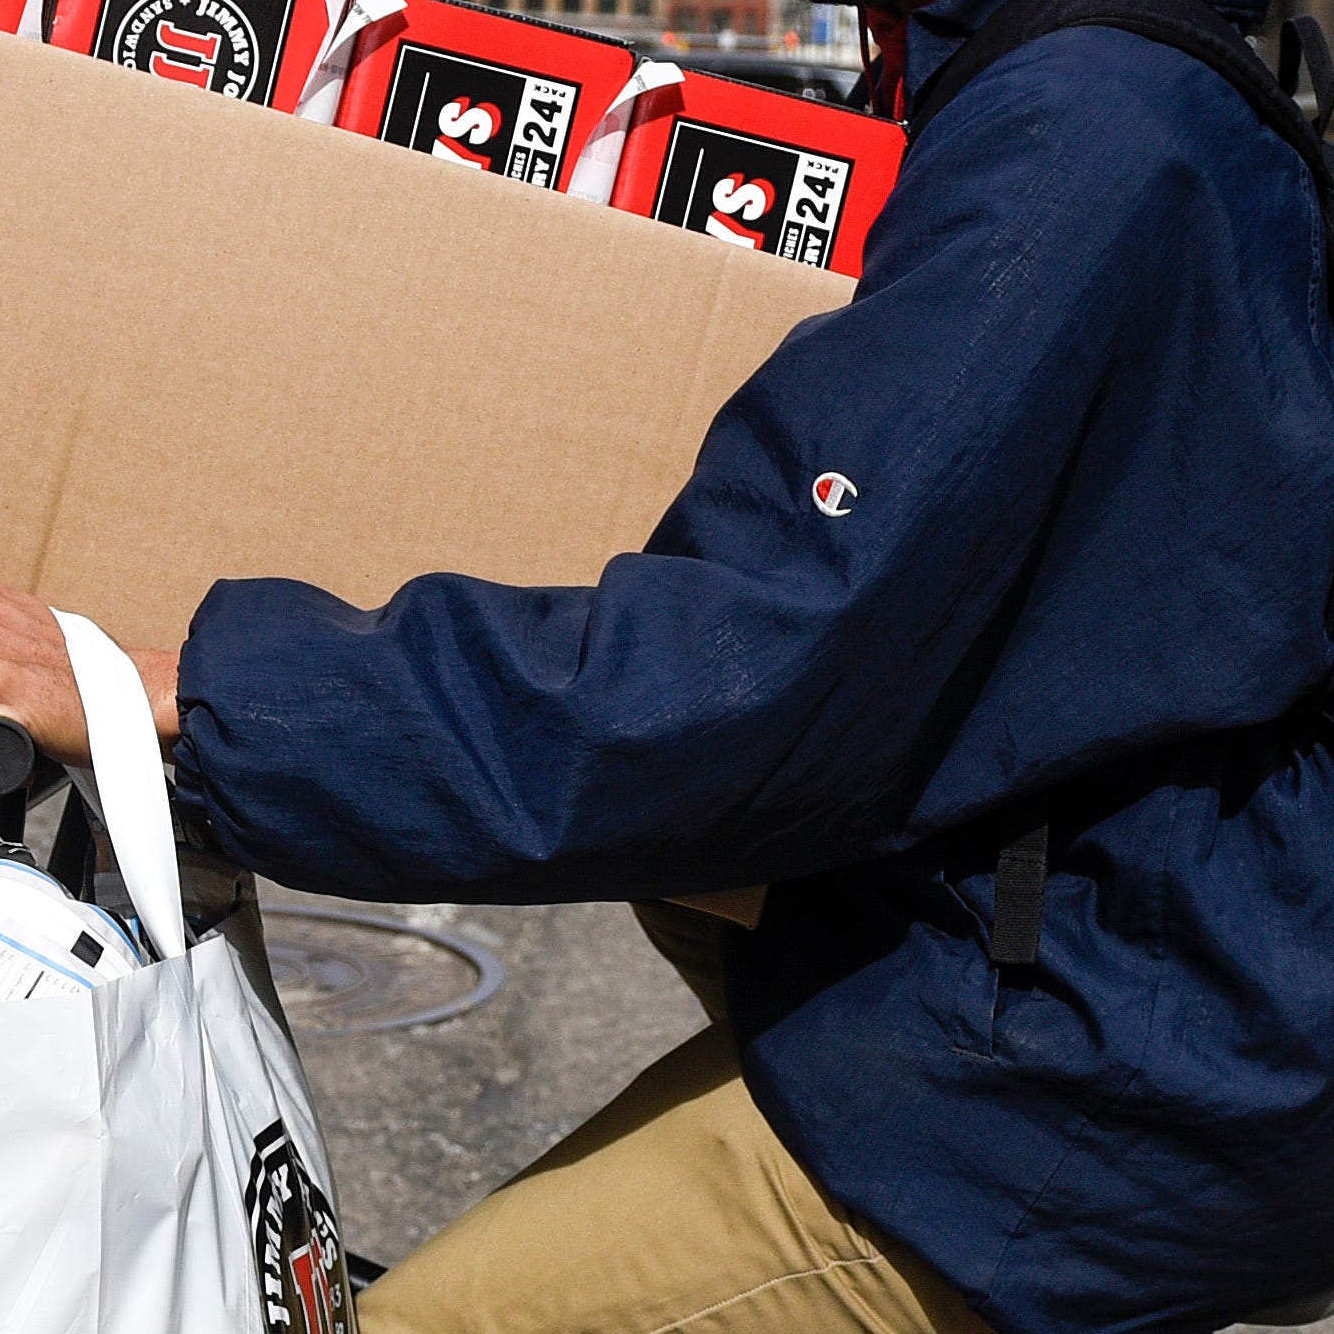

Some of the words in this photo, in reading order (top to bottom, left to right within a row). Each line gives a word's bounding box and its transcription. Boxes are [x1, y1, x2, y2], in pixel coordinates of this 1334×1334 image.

[533, 83, 566, 98] PACK
[522, 97, 563, 148] 24
[807, 159, 839, 174] PACK
[795, 173, 836, 224] 24
